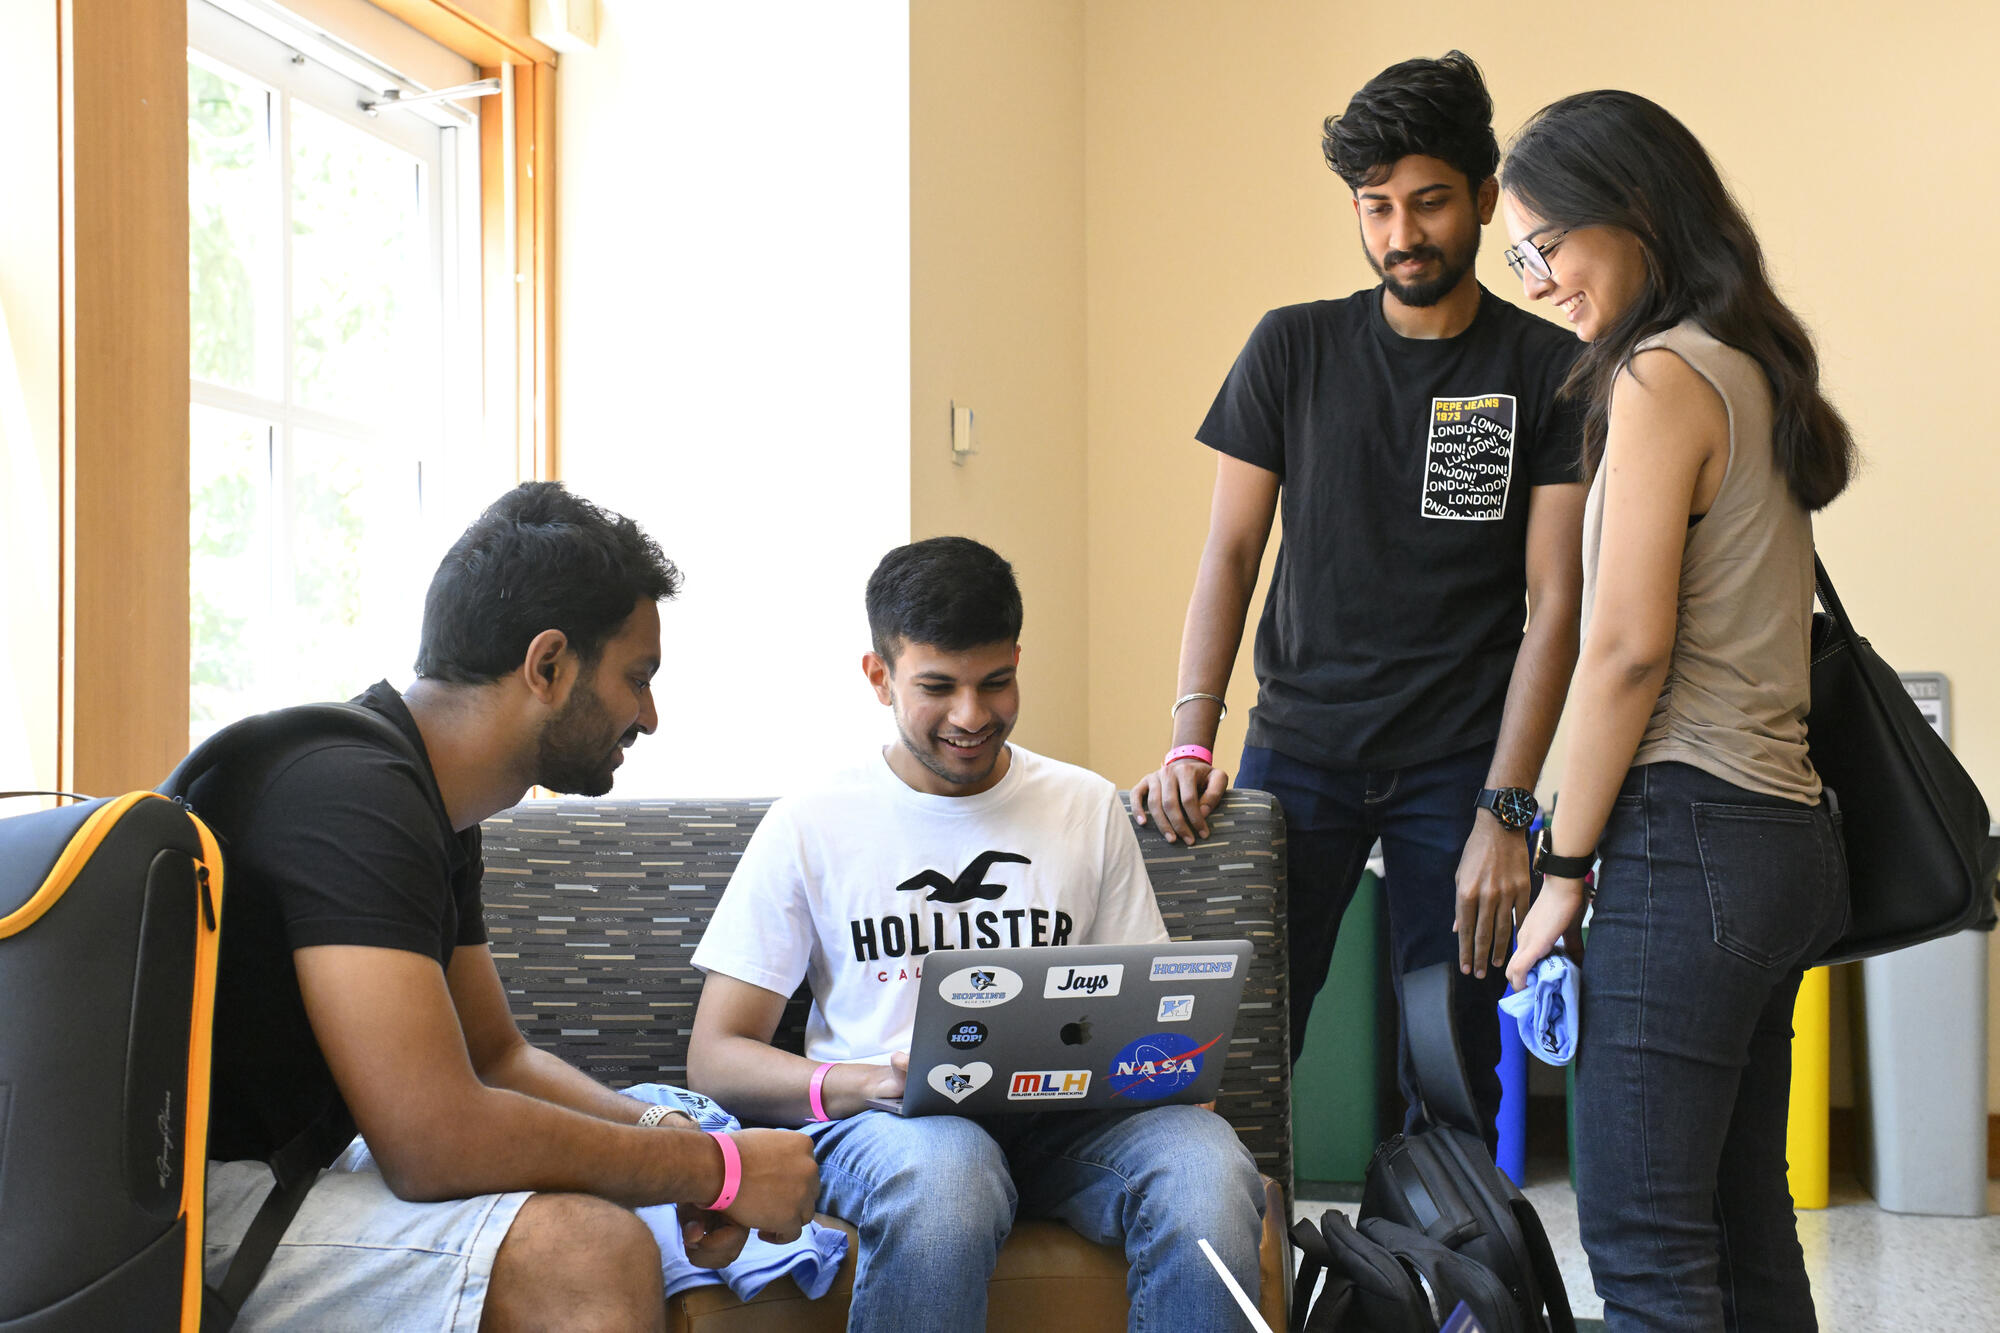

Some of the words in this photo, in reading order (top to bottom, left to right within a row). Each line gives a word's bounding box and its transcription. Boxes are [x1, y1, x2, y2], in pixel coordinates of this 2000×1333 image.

[1436, 401, 1462, 411] PEPE
[1464, 398, 1499, 410] JEANS
[1436, 412, 1461, 421] 1973
[1448, 494, 1501, 505] LONDON!
[851, 908, 1073, 962] HOLLISTER
[1153, 961, 1233, 975] HOPKINS
[1057, 969, 1109, 994] Jays
[951, 992, 1006, 1000] HOPKINS
[960, 1026, 978, 1034] GO
[951, 1034, 983, 1042] HOP!
[1116, 1059, 1196, 1075] NASA
[1012, 1073, 1088, 1092] MLH
